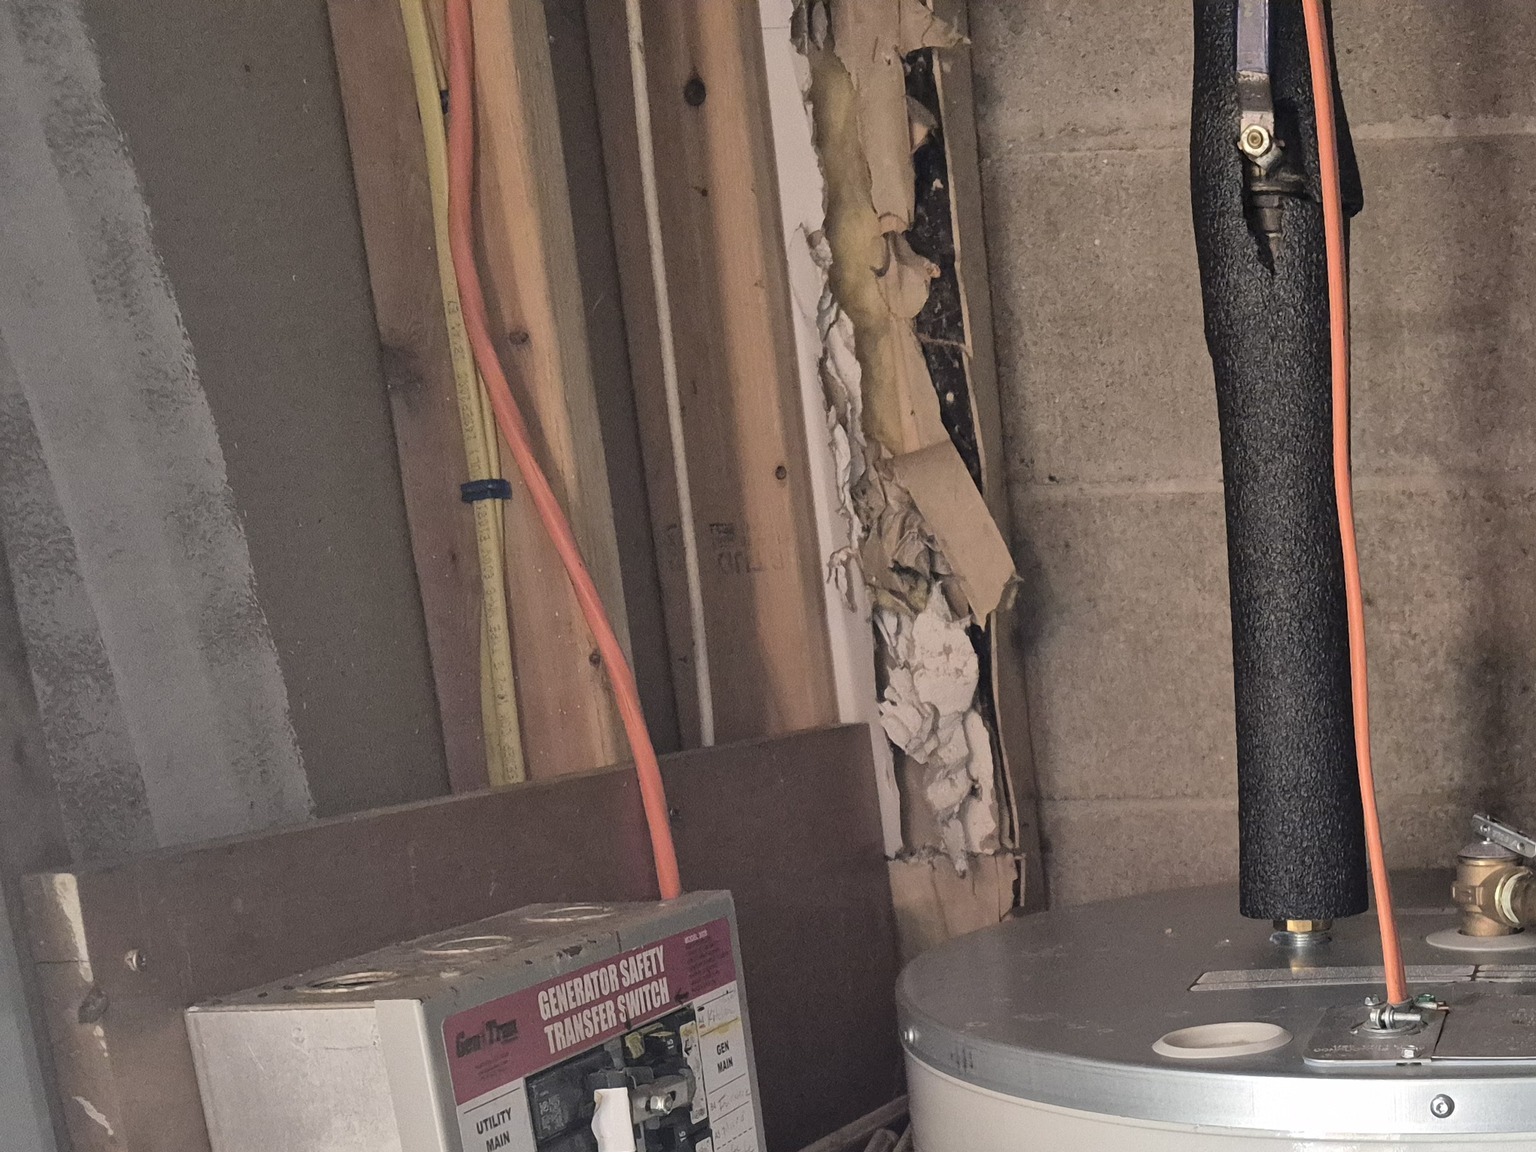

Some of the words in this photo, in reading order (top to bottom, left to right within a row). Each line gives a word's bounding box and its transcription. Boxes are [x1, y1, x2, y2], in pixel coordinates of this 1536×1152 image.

[537, 963, 620, 1021] GENERATOR
[619, 944, 666, 988] SAFETY
[543, 1000, 618, 1055] TRANSFER
[617, 976, 671, 1023] SWITCH
[667, 1038, 675, 1050] 15
[716, 1040, 730, 1056] GEN
[717, 1057, 734, 1074] MAIN
[476, 1107, 512, 1135] UTILITY
[485, 1131, 511, 1152] MAIN
